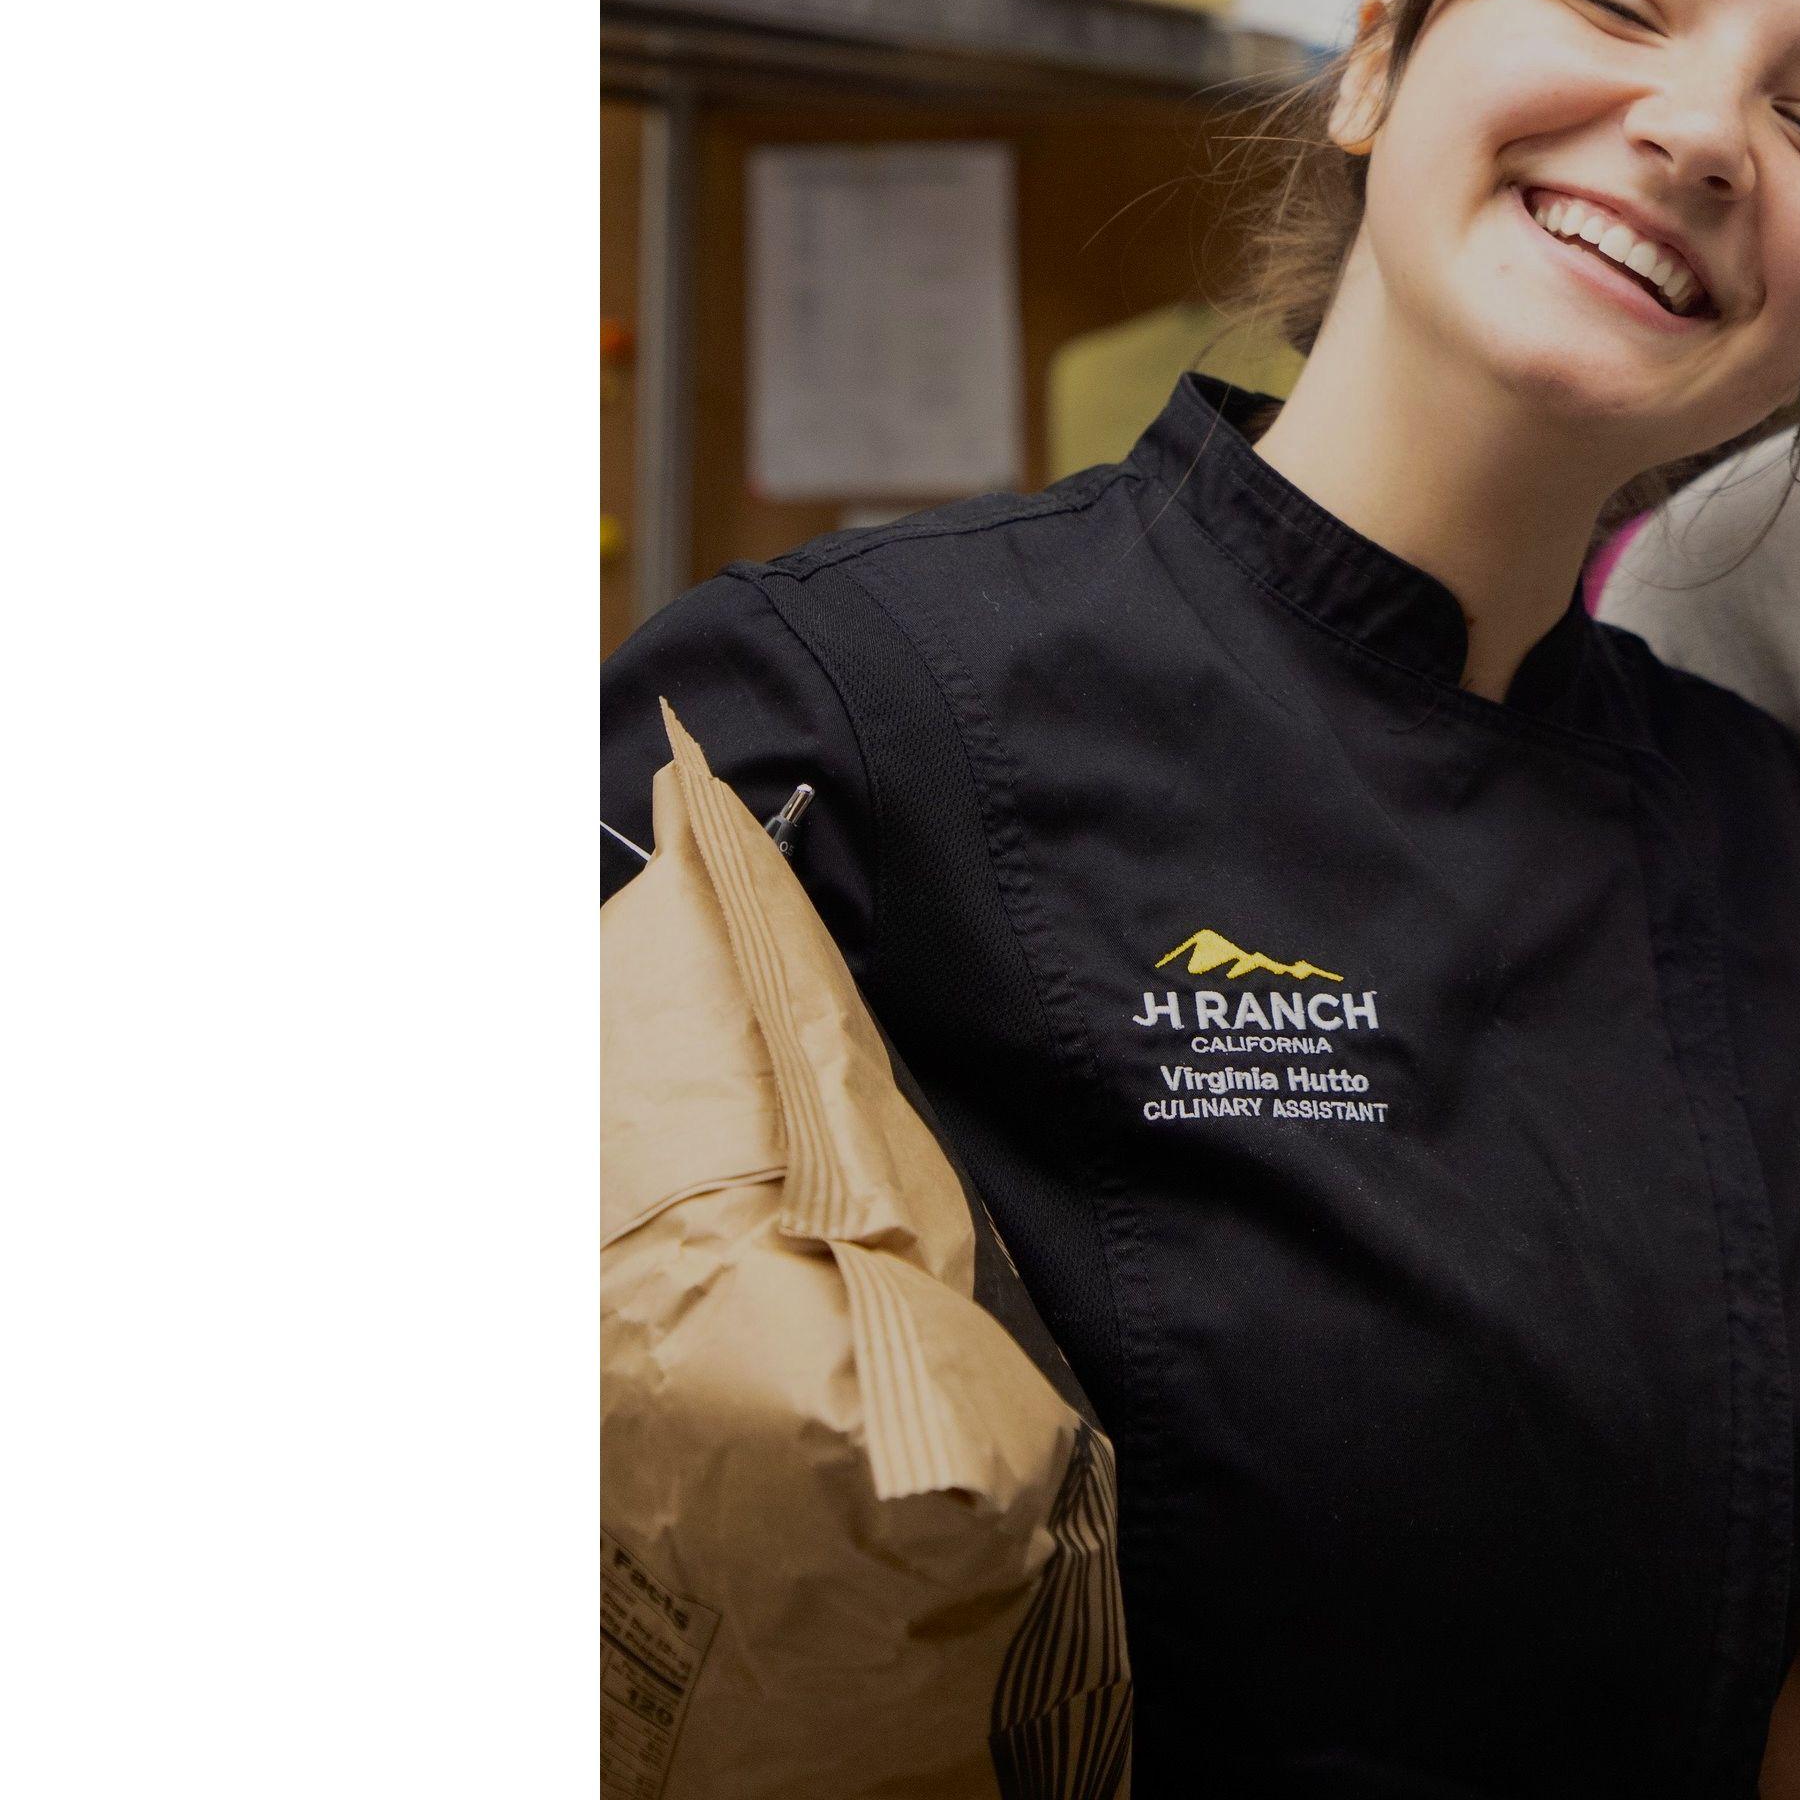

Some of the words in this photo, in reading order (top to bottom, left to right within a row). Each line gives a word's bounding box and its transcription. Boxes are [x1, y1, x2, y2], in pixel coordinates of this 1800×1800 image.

[1132, 991, 1185, 1031] JH
[1195, 990, 1379, 1031] RANCH
[1191, 1036, 1333, 1056] CALIFORNIA
[1160, 1063, 1280, 1095] Virginia
[1286, 1066, 1370, 1093] Hutto
[1143, 1097, 1263, 1121] CULINARY
[1272, 1098, 1389, 1123] ASSISTANT
